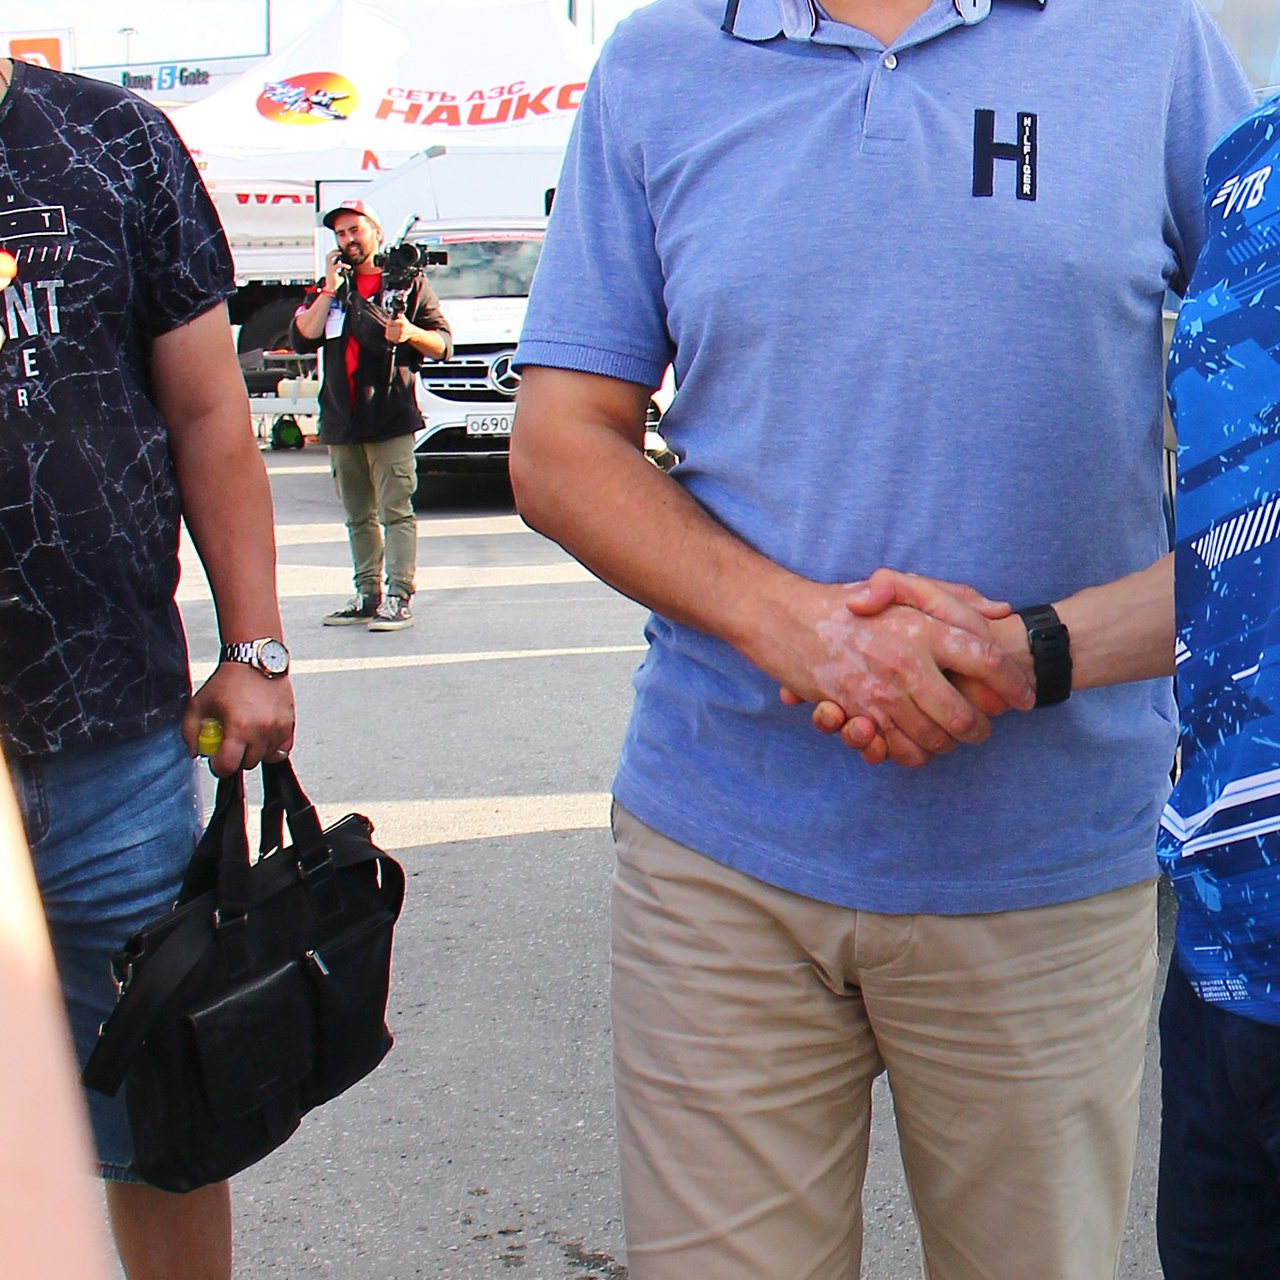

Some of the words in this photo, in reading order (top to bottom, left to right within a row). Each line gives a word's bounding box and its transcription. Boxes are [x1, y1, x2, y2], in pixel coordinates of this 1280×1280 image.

[160, 67, 171, 88] 5
[178, 67, 209, 87] Gate
[387, 86, 456, 103] СЕТЬ
[465, 80, 526, 103] АЗС
[1022, 116, 1032, 195] HILFIGER
[1222, 165, 1272, 219] VTB
